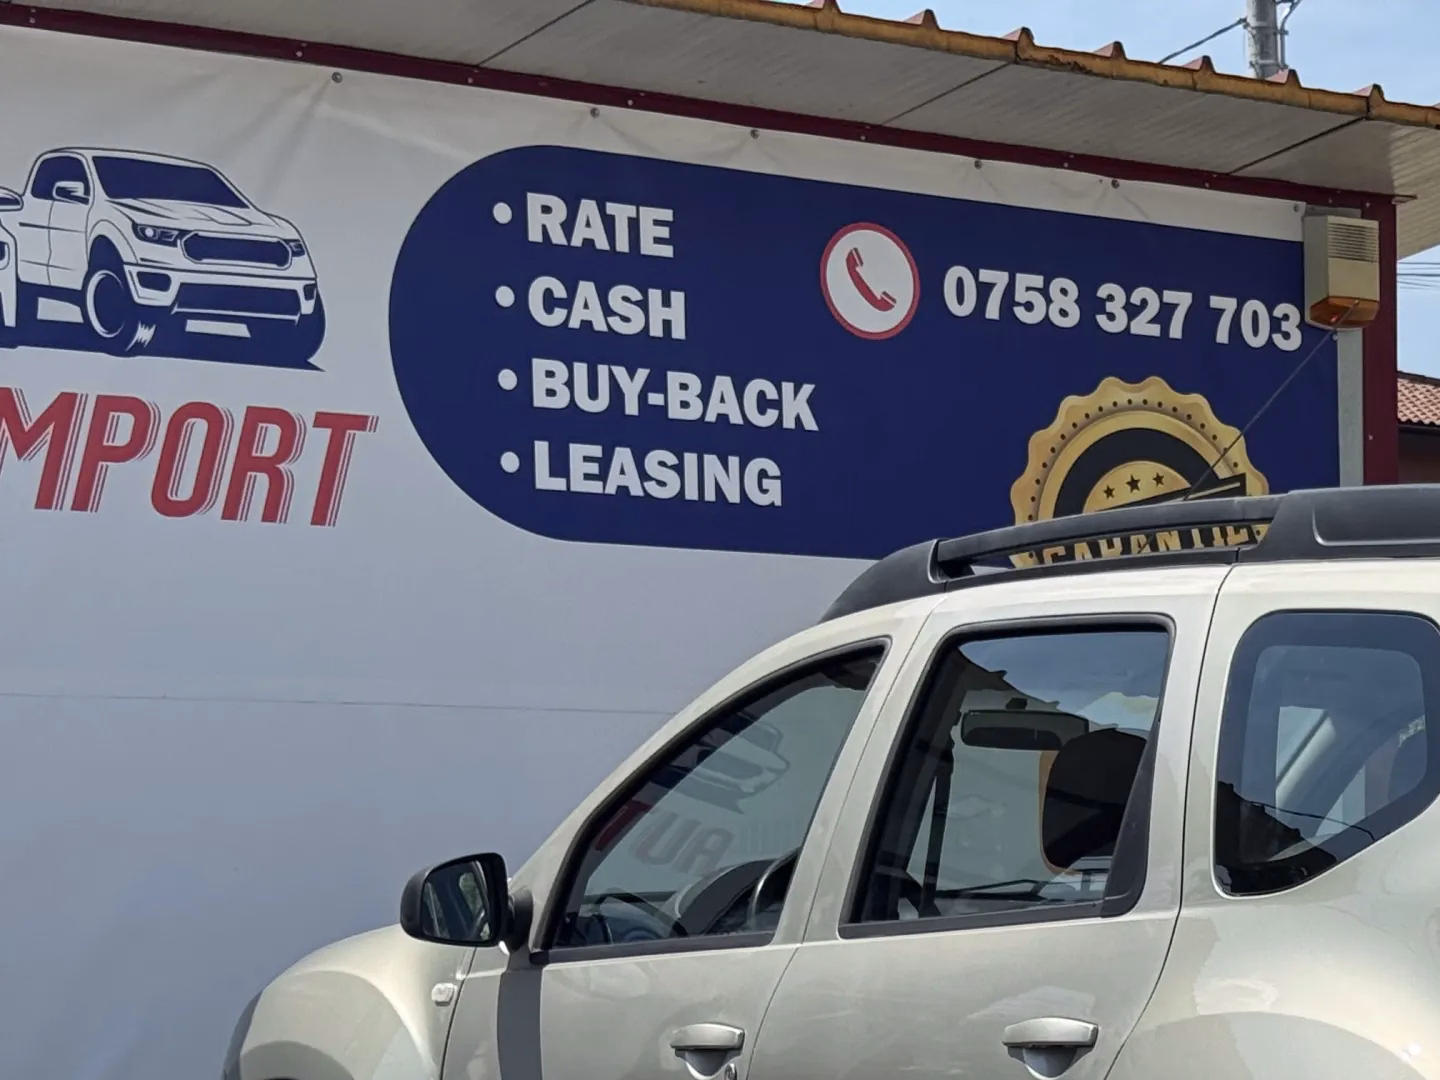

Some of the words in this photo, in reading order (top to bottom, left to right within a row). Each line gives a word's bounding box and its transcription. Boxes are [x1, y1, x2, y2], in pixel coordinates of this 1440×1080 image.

[525, 192, 675, 258] RATE
[527, 275, 686, 340] CASH
[942, 264, 1081, 329] 0758
[1094, 282, 1193, 341] 327
[1209, 294, 1303, 352] 703
[531, 357, 819, 432] BUY-BACK
[533, 439, 783, 507] LEASING
